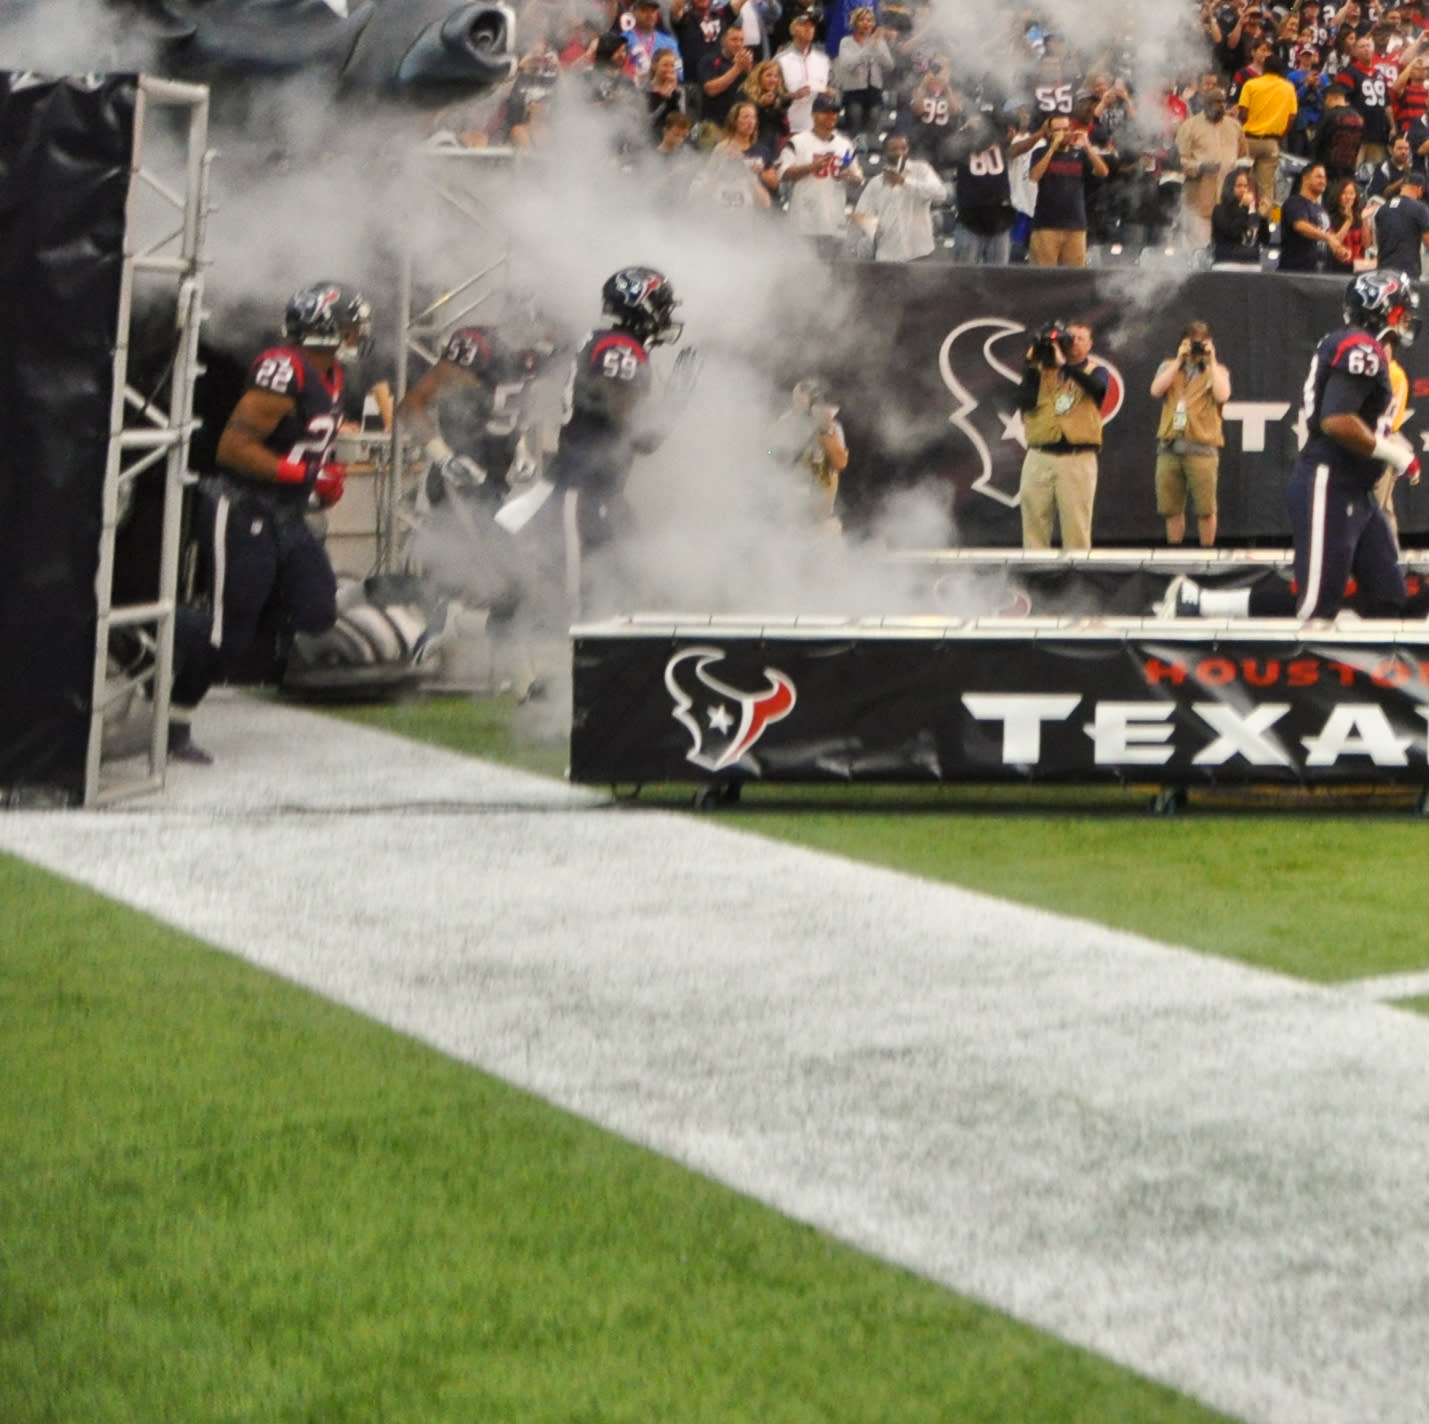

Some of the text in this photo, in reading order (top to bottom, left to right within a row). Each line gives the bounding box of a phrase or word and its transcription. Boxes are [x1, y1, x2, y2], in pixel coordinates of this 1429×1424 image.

[1035, 83, 1073, 113] 55
[1362, 79, 1386, 107] 99
[921, 98, 949, 126] 99
[255, 353, 295, 393] 22
[602, 351, 637, 381] 59
[1347, 350, 1381, 377] 63
